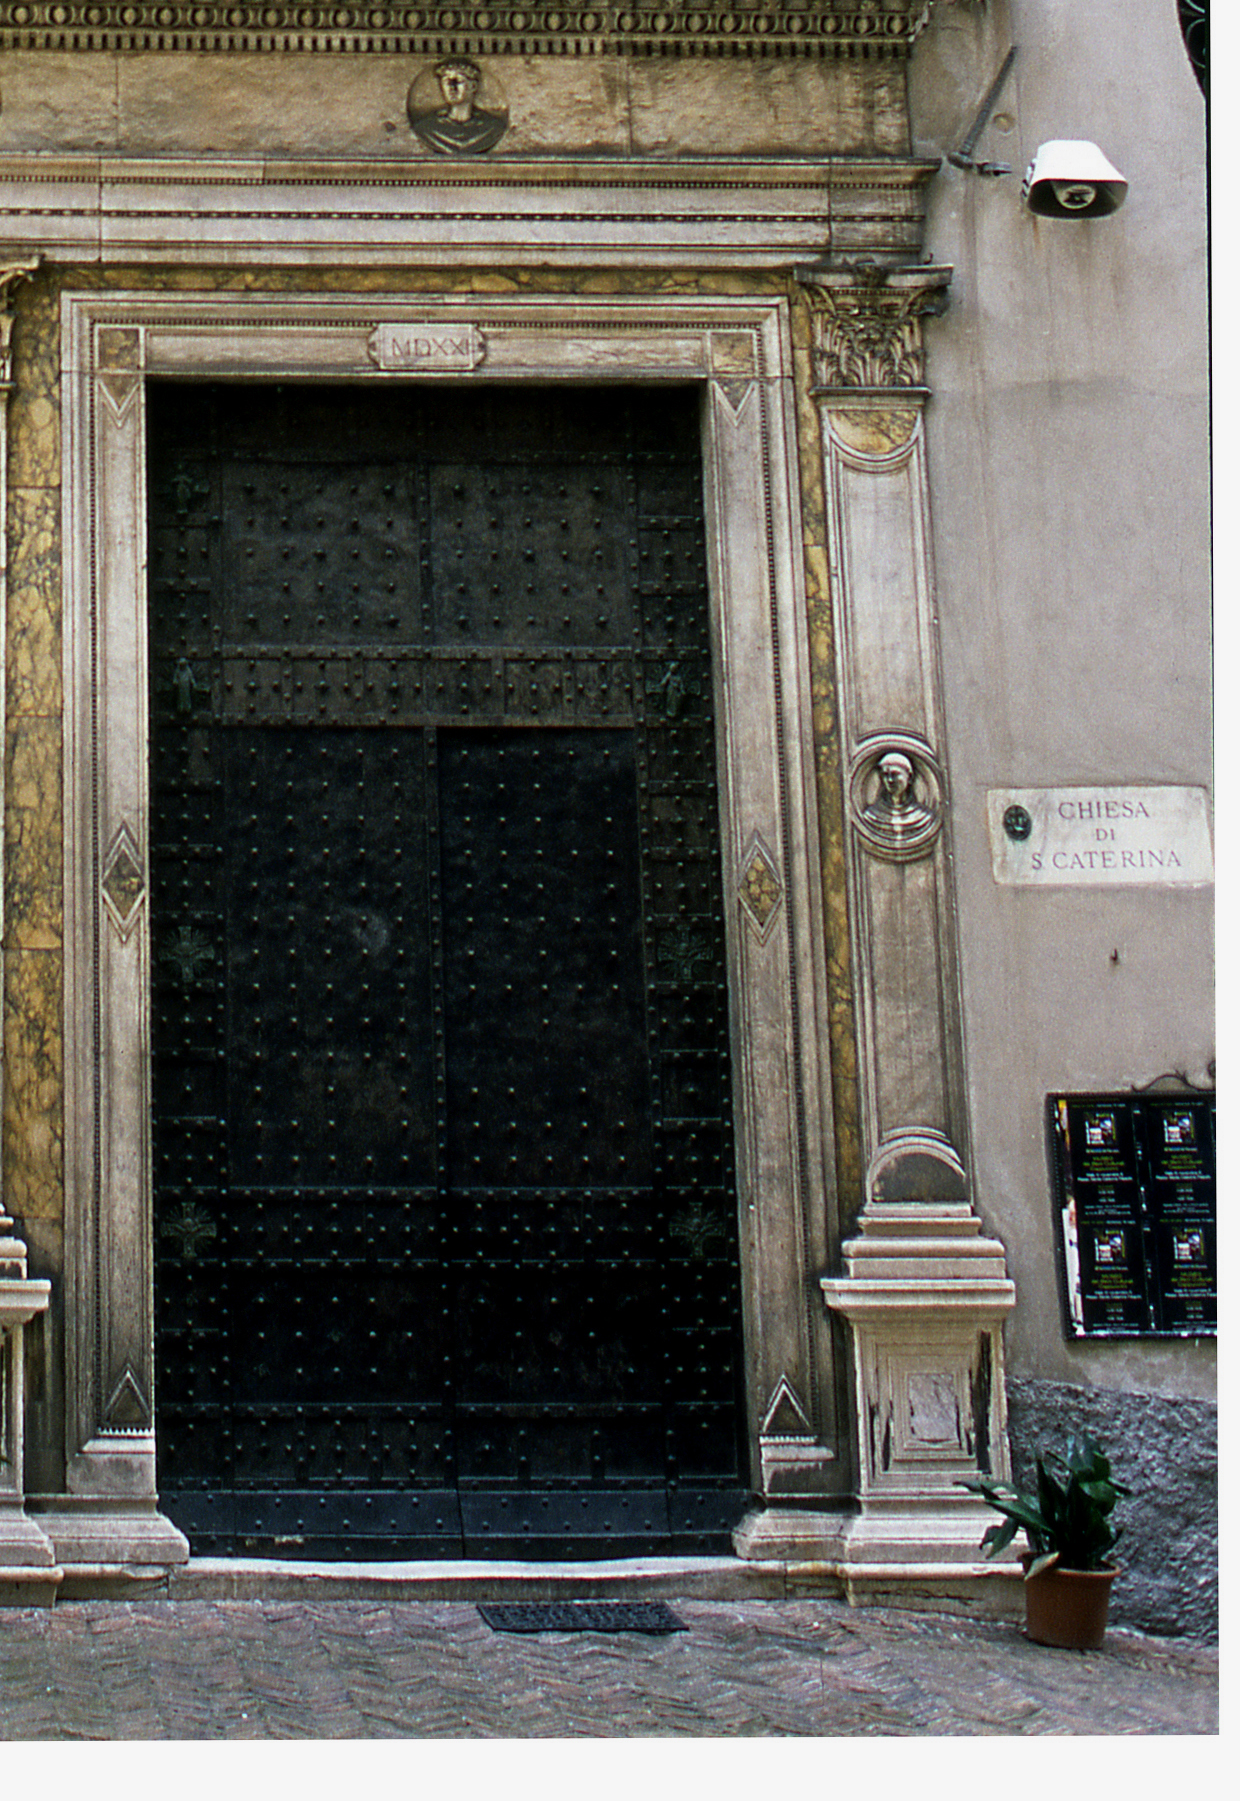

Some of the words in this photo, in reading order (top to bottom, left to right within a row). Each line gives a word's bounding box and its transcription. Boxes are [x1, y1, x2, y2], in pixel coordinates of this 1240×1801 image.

[1058, 801, 1150, 819] CHIESA
[1095, 828, 1115, 841] DI
[1052, 850, 1181, 869] CATERINA
